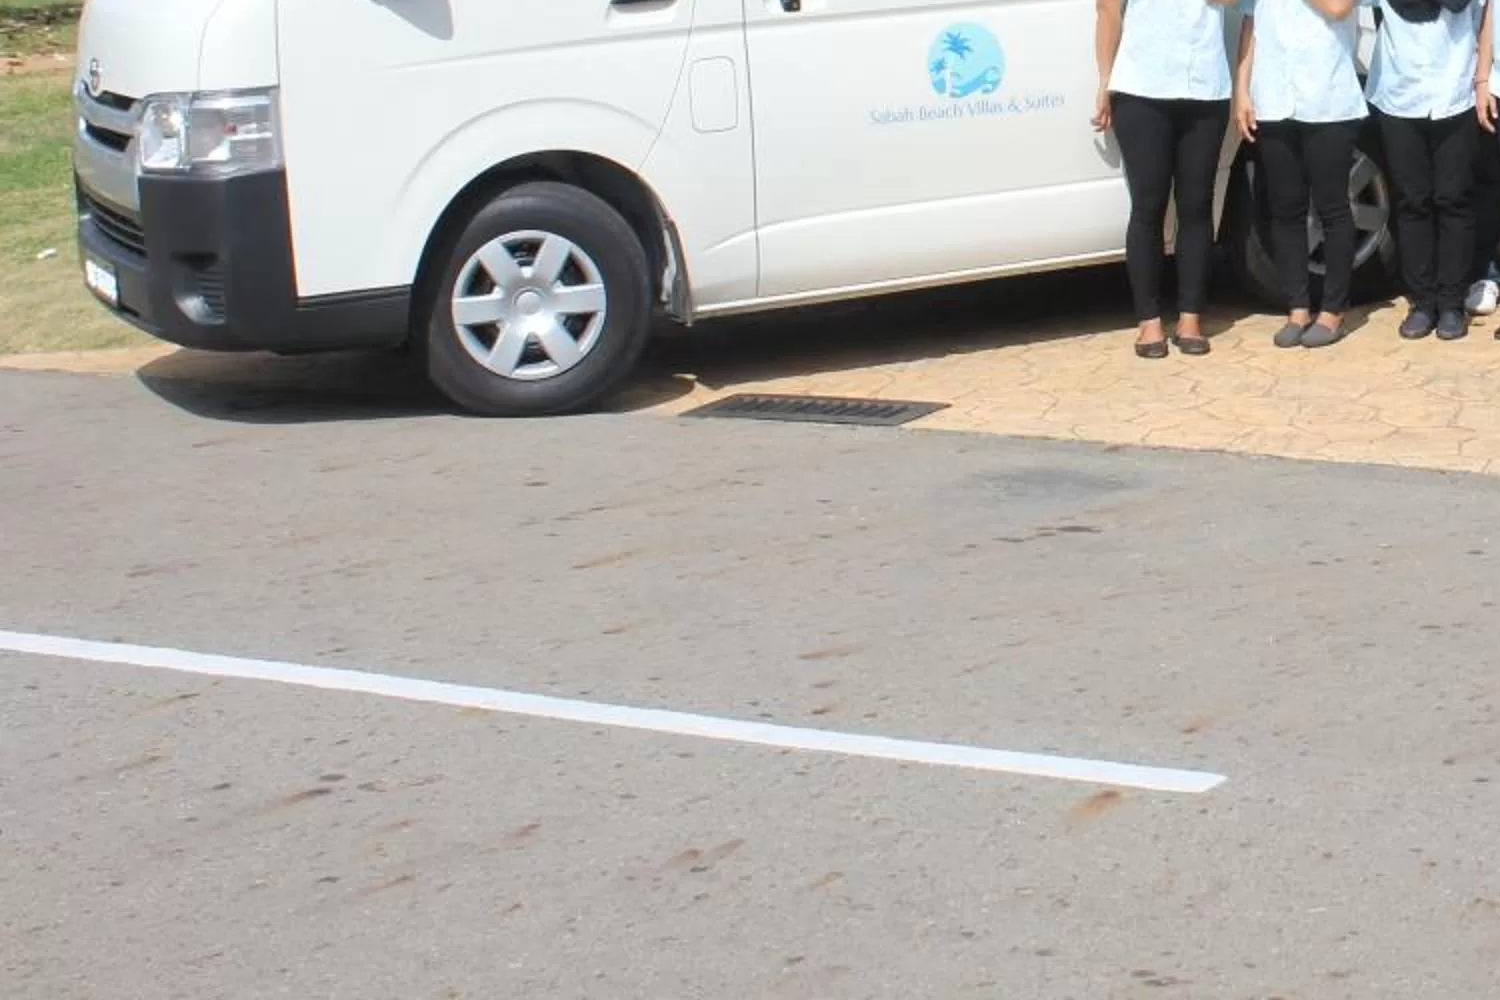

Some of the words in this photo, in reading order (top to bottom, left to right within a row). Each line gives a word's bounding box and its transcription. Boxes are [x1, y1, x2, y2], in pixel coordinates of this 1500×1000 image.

[869, 104, 915, 124] Sabah
[919, 102, 963, 121] Beach
[966, 99, 1005, 118] Villas
[1008, 99, 1021, 114] &
[1025, 93, 1066, 110] Suites
